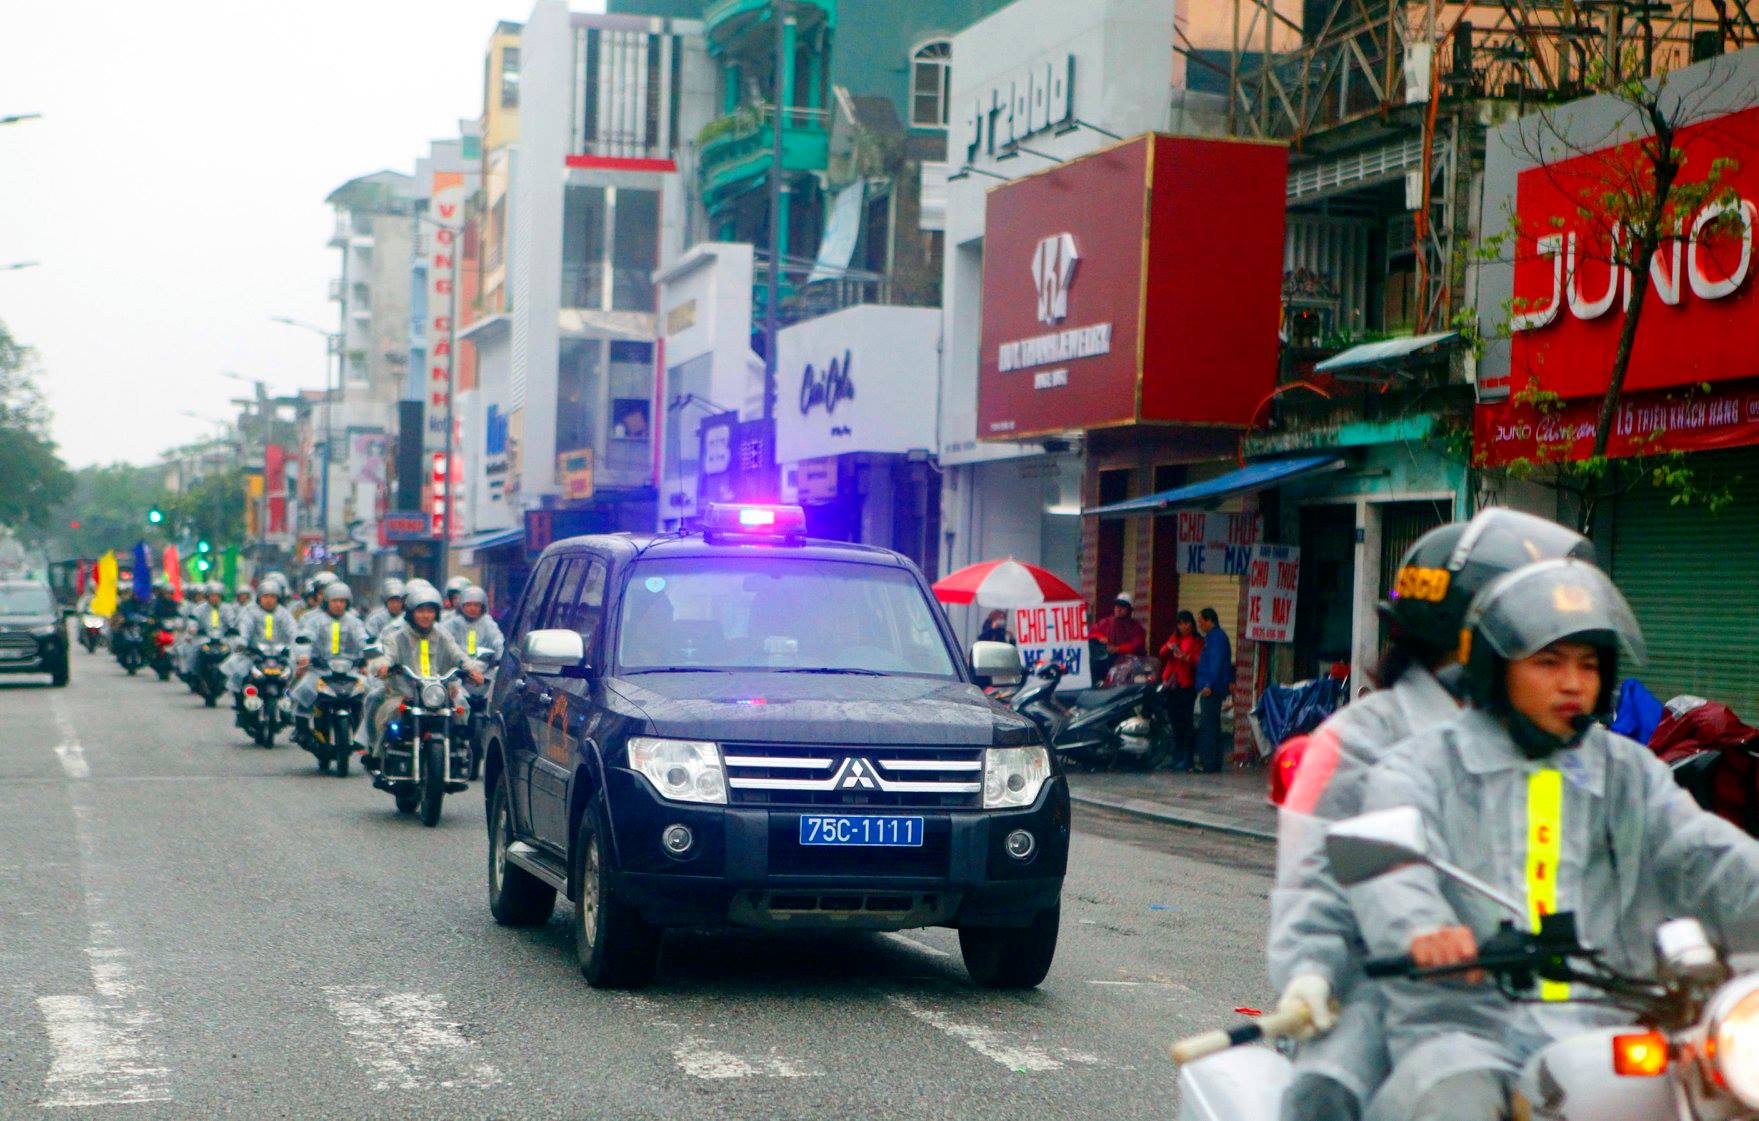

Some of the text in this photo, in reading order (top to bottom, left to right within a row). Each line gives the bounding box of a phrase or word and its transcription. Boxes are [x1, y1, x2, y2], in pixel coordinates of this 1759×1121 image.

[1510, 198, 1757, 332] JUNO
[1179, 511, 1206, 543] CHO
[1187, 543, 1206, 574] XE
[1251, 559, 1269, 588] CHO
[1250, 594, 1261, 624] XE
[808, 818, 913, 843] 75C-1111
